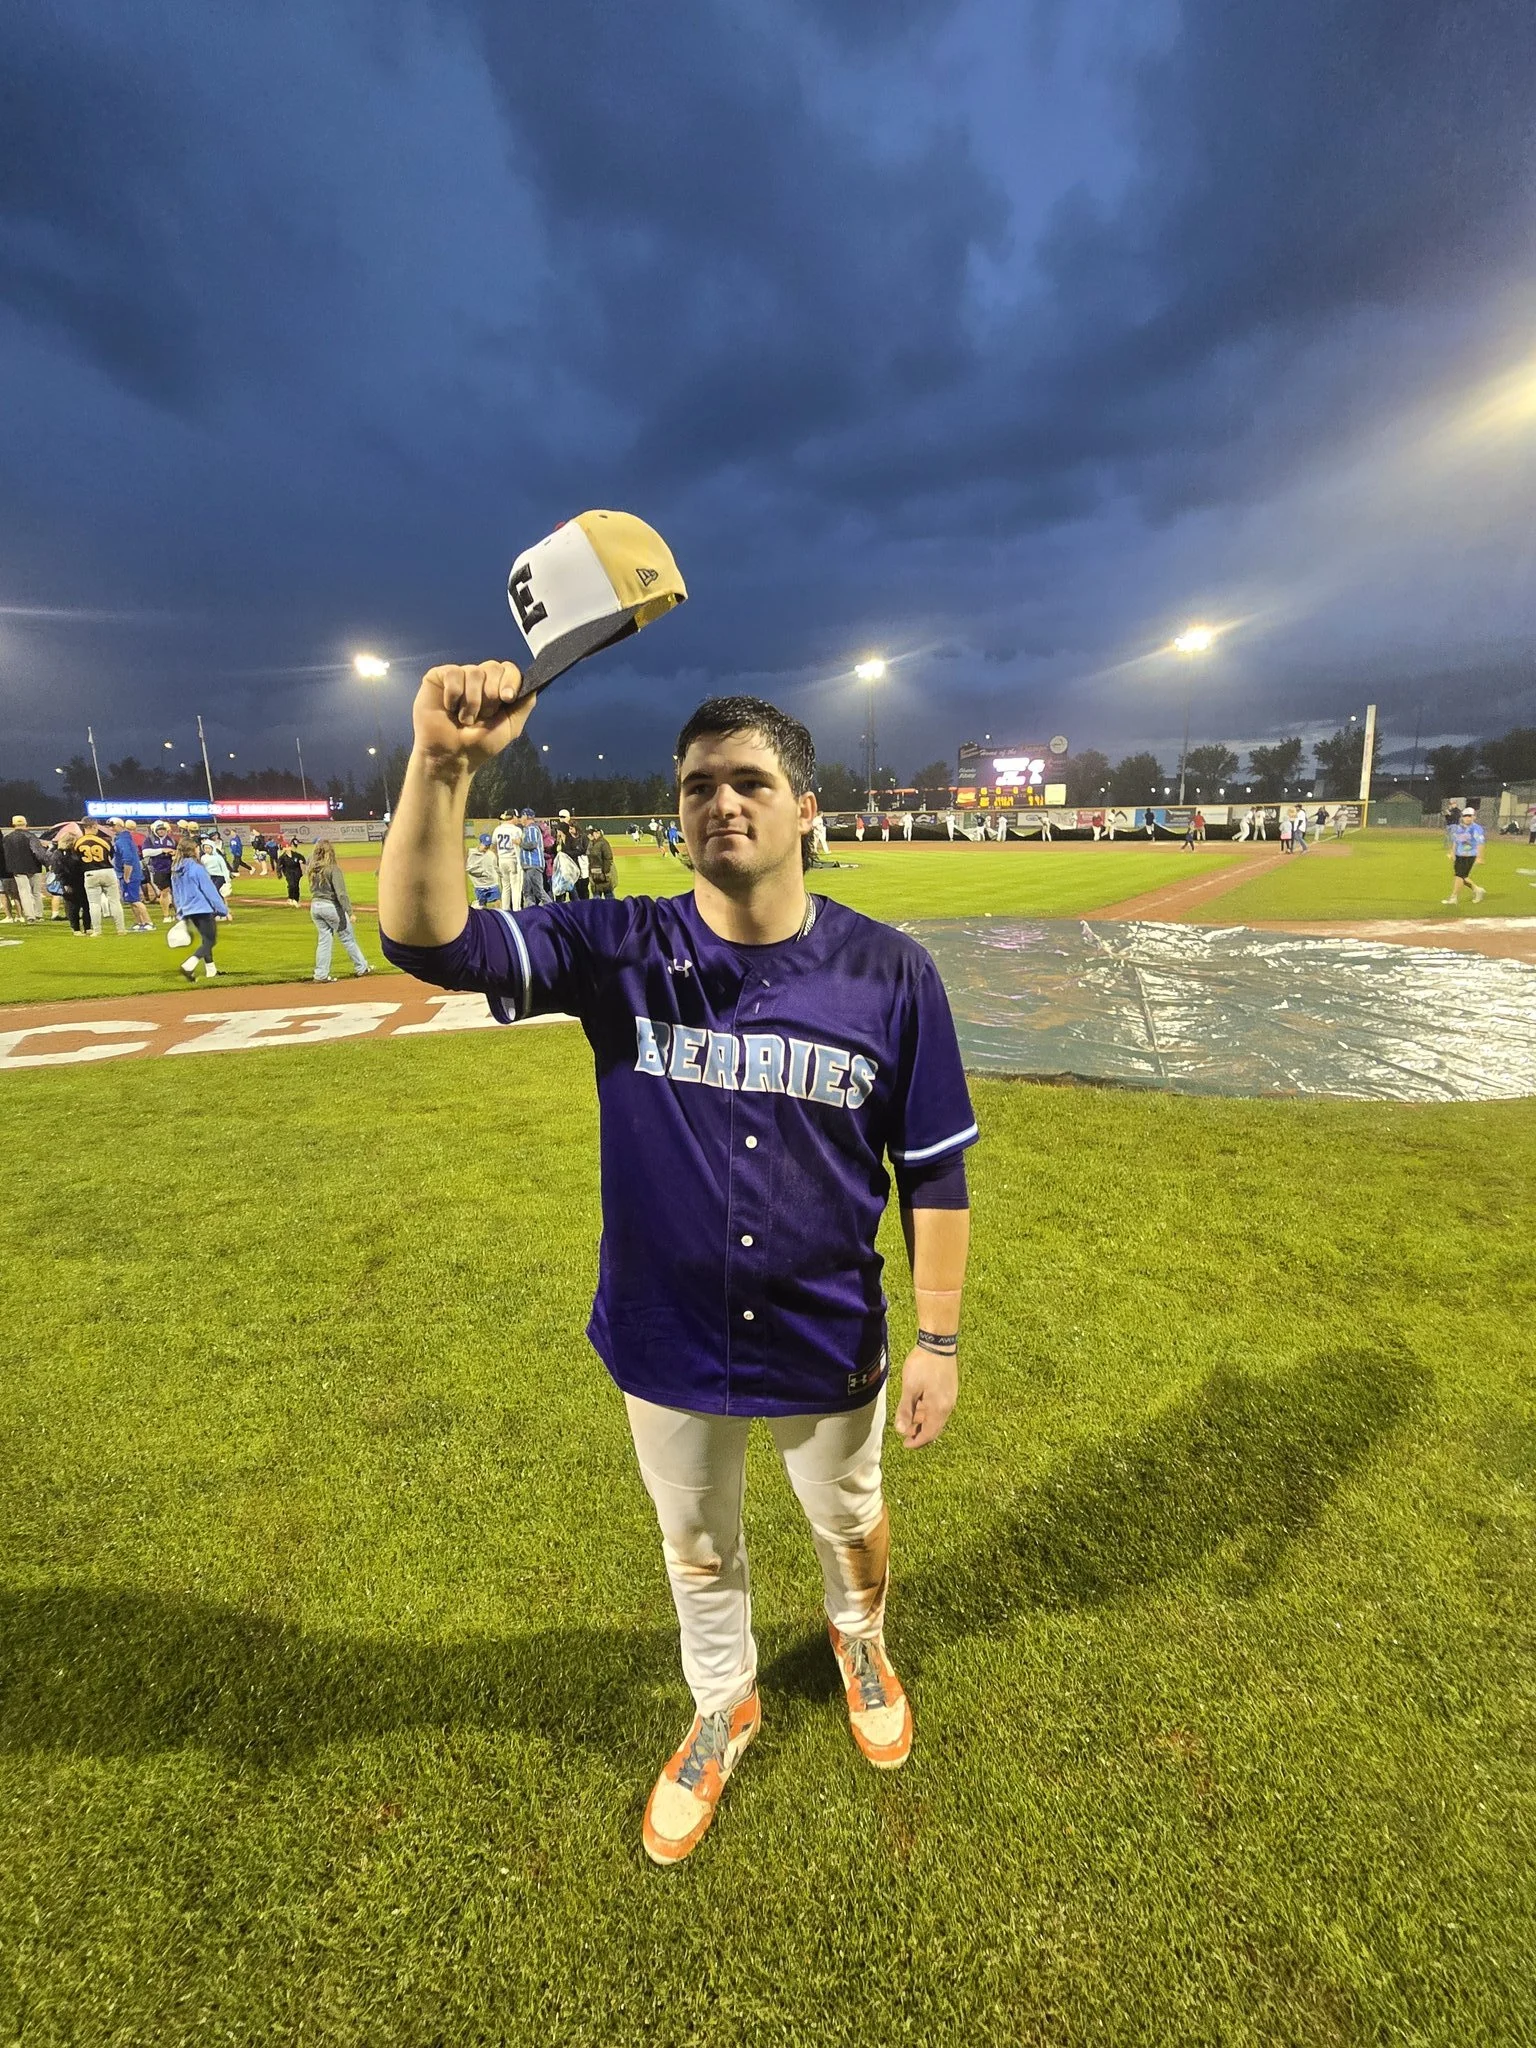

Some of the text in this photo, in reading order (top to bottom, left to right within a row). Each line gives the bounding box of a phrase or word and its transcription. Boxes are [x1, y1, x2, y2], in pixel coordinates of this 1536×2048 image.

[508, 562, 548, 635] E
[78, 844, 105, 863] 39
[497, 834, 514, 850] 22
[634, 1016, 879, 1109] BERRIES
